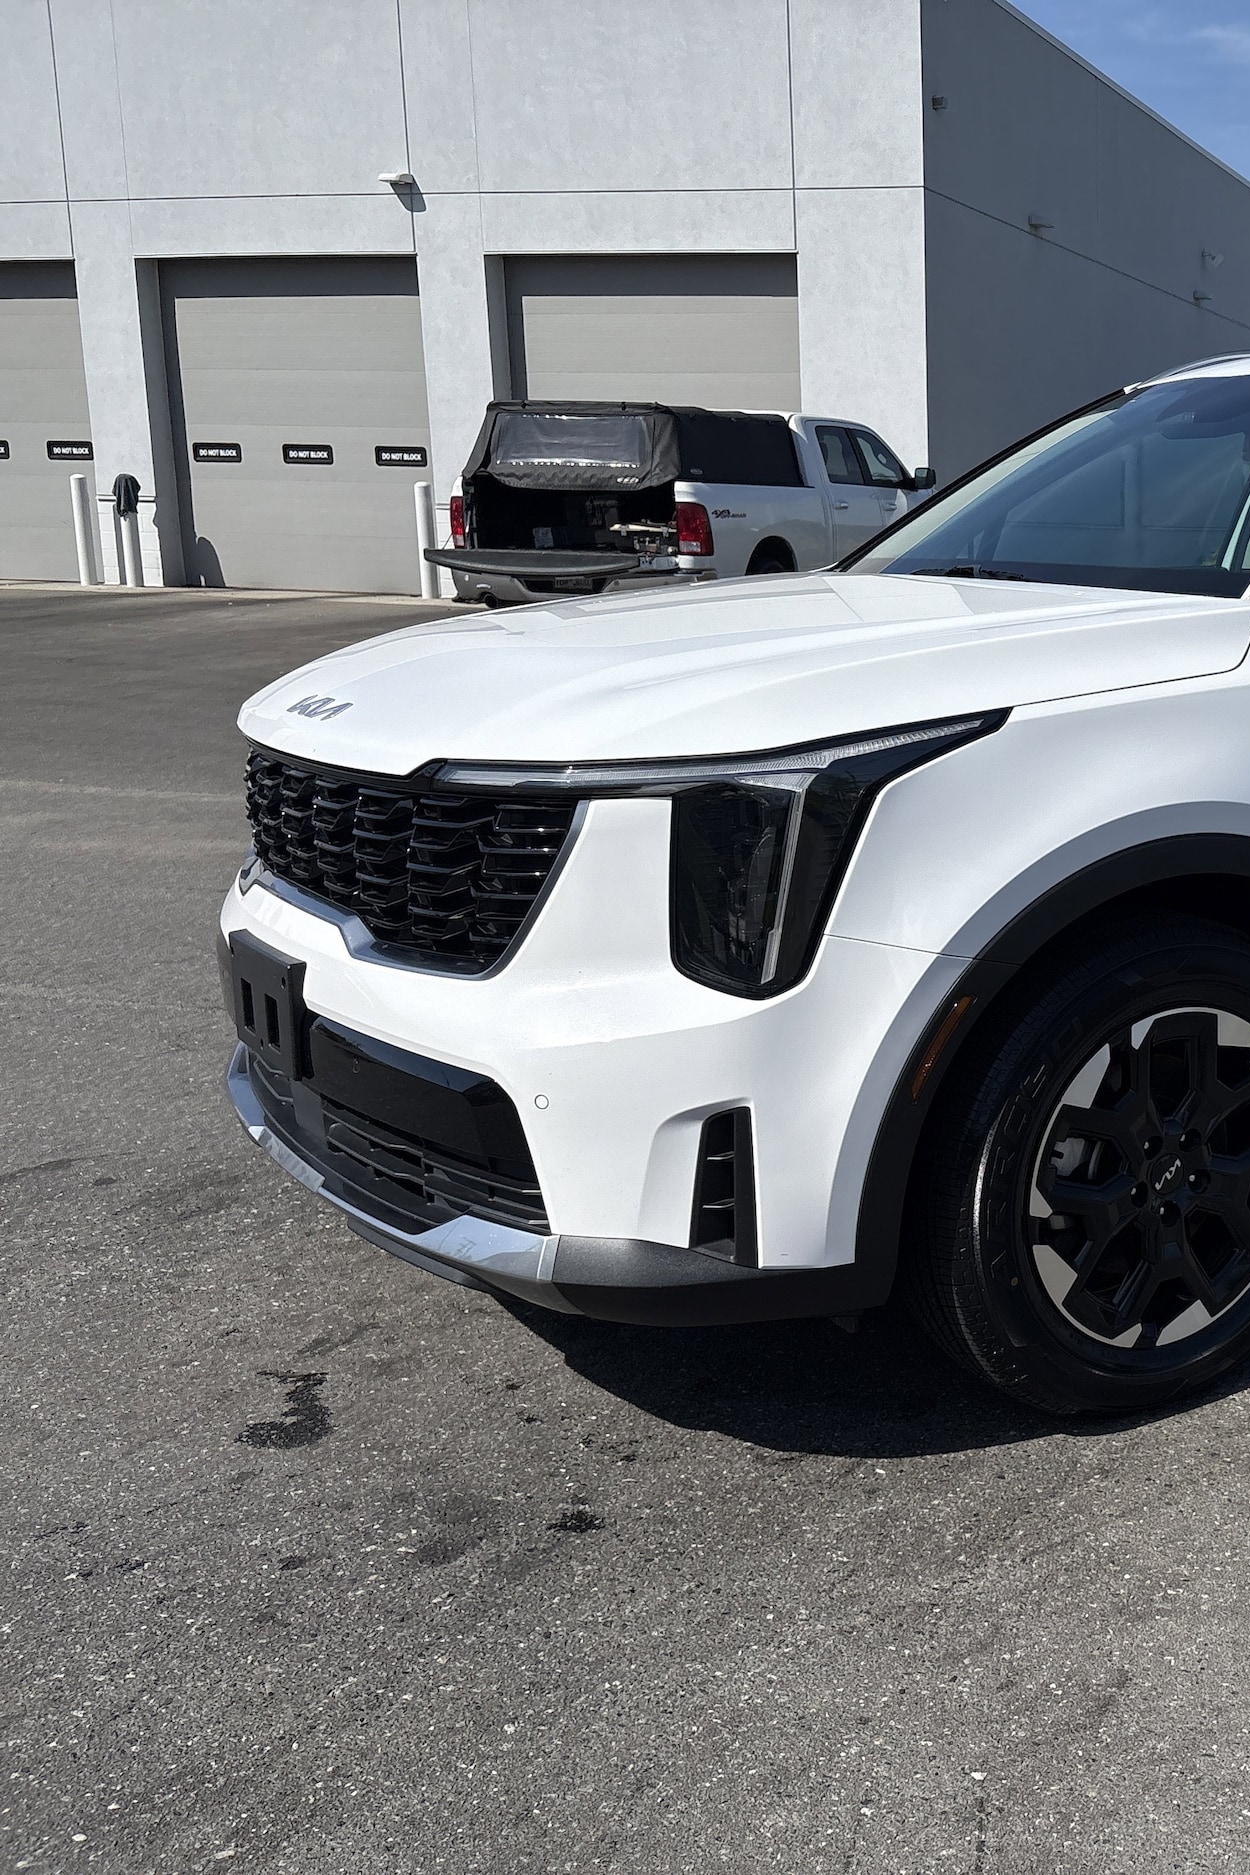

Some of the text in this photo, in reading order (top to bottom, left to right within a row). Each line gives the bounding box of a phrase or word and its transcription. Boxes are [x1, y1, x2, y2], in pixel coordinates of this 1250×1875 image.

[220, 449, 237, 457] BLOCK
[310, 451, 328, 459] BLOCK
[381, 452, 422, 461] DO NOT BLOCK
